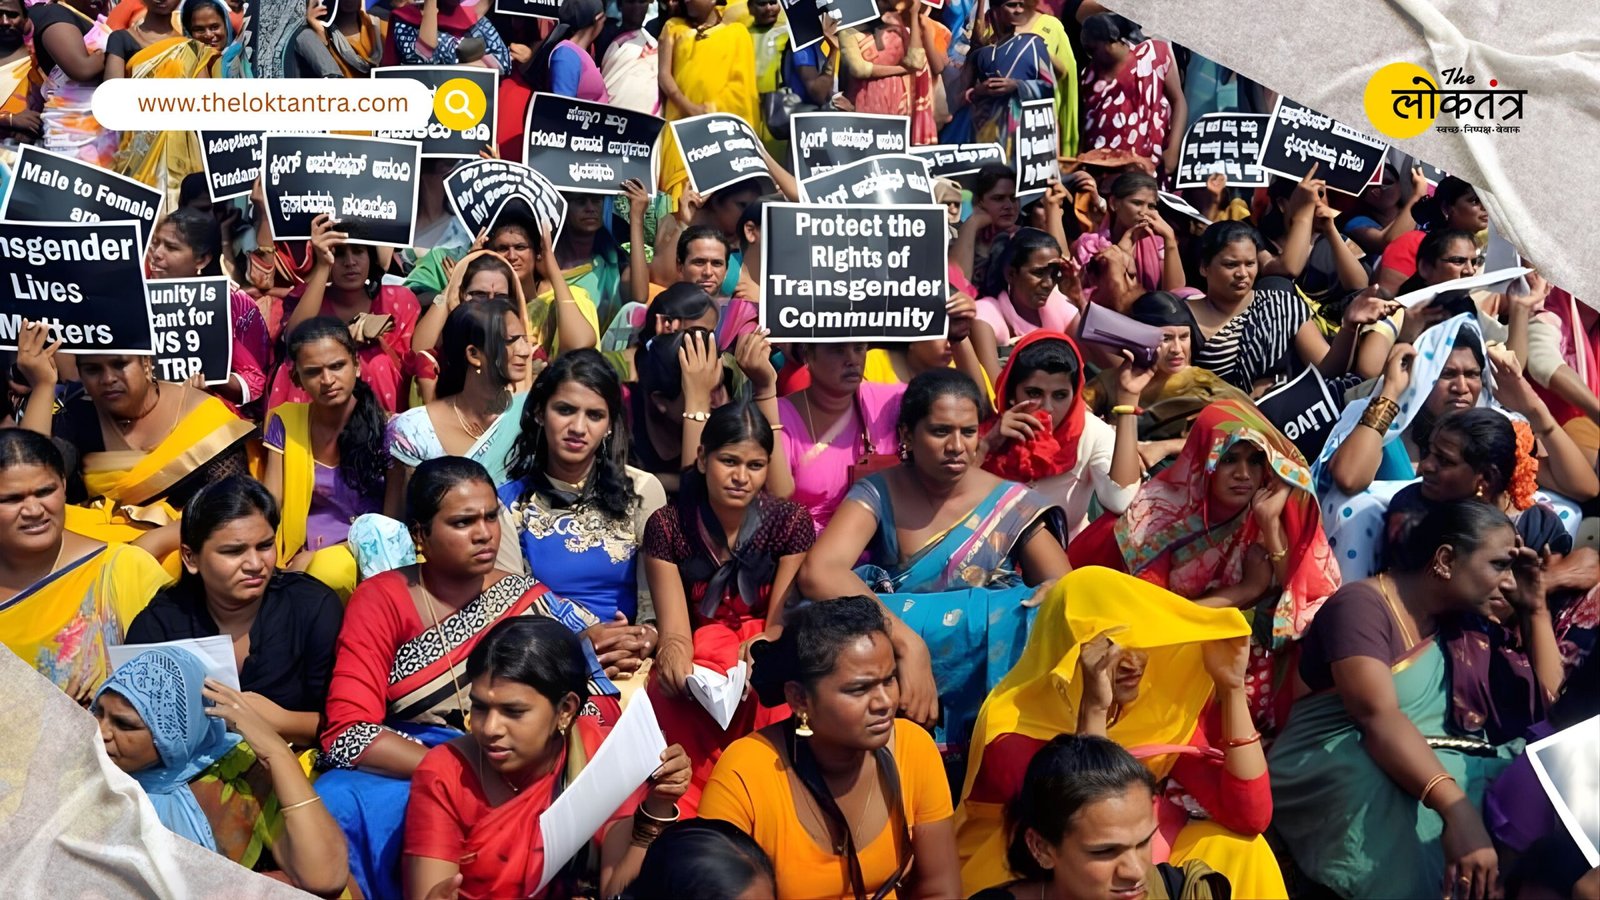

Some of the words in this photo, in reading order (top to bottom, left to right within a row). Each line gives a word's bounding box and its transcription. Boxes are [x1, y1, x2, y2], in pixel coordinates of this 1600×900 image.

[21, 161, 70, 191] Male
[73, 176, 93, 198] to
[95, 184, 155, 221] Female
[70, 207, 101, 222] are
[795, 212, 883, 237] Protect
[887, 213, 926, 237] the
[0, 232, 133, 266] nsgender
[812, 246, 883, 273] Rights
[887, 245, 911, 268] of
[10, 272, 84, 303] Lives
[769, 274, 942, 301] Transgender
[0, 313, 114, 345] Mtters
[188, 306, 215, 326] for
[778, 306, 935, 332] Community
[185, 329, 200, 352] 9
[1284, 400, 1333, 440] Live
